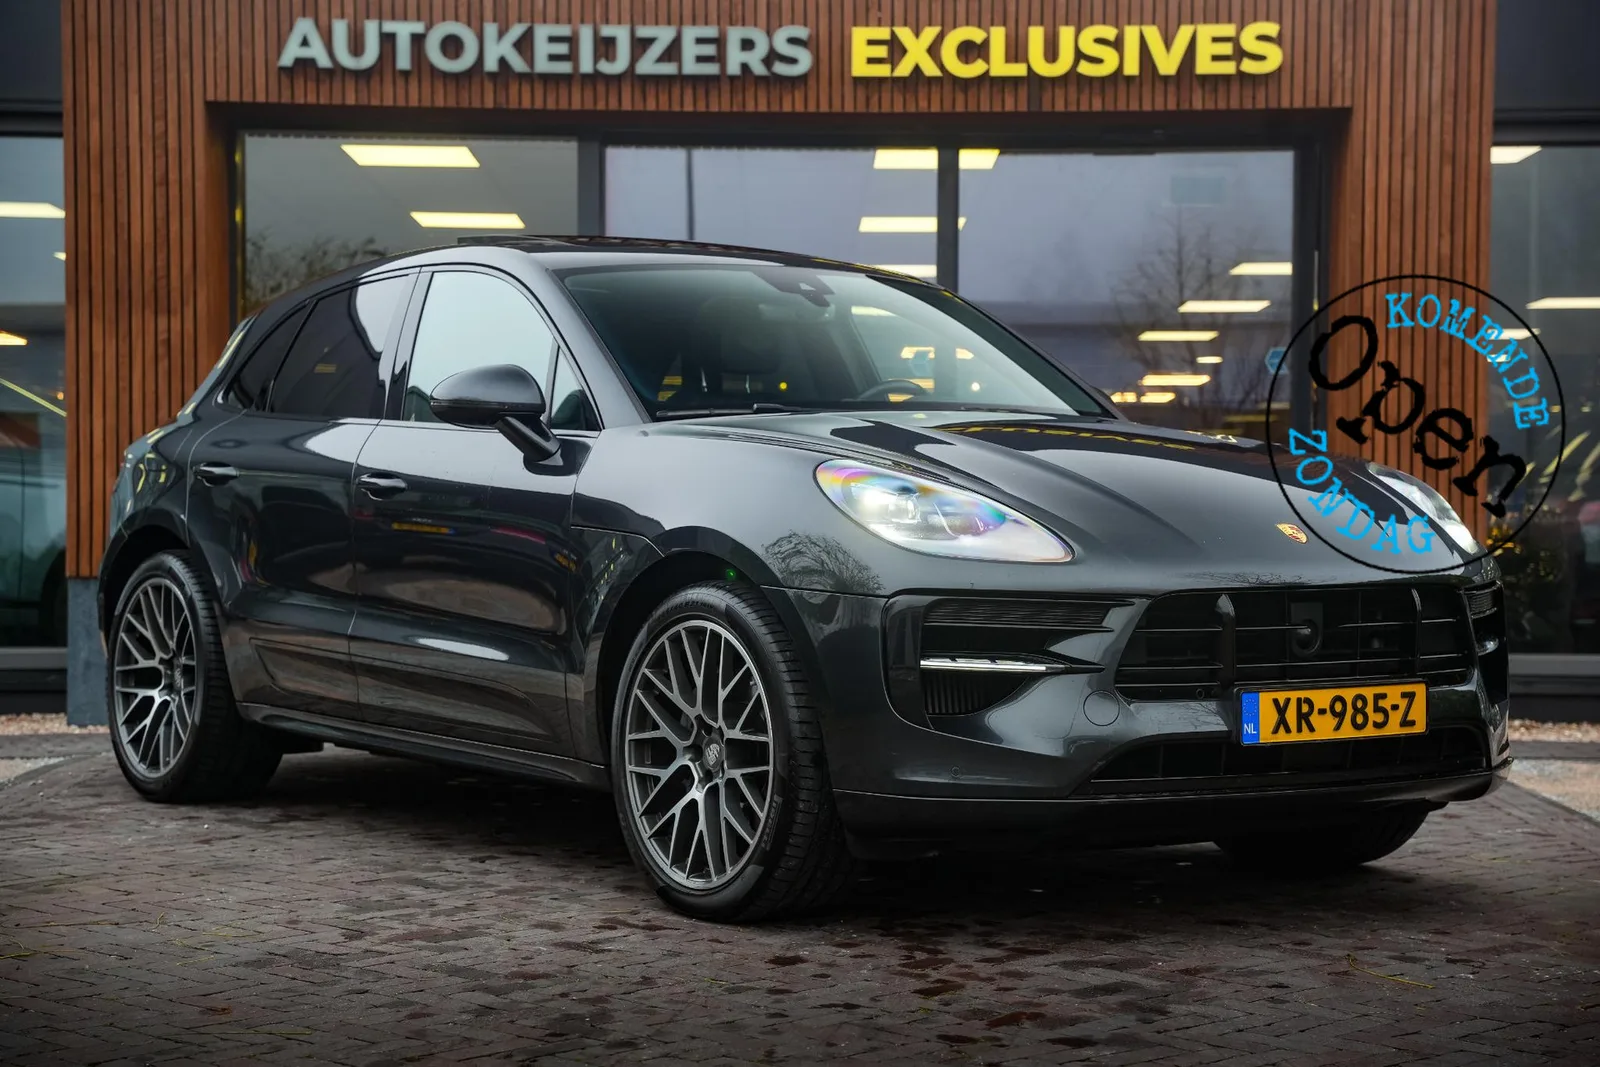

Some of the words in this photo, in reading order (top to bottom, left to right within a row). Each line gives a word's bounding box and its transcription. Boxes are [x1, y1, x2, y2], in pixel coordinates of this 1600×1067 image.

[277, 17, 813, 76] AUTOKEIJZERS
[851, 22, 1283, 78] EXCLUSIVES
[1243, 723, 1257, 734] NL
[1271, 691, 1417, 735] XR-985-Z
